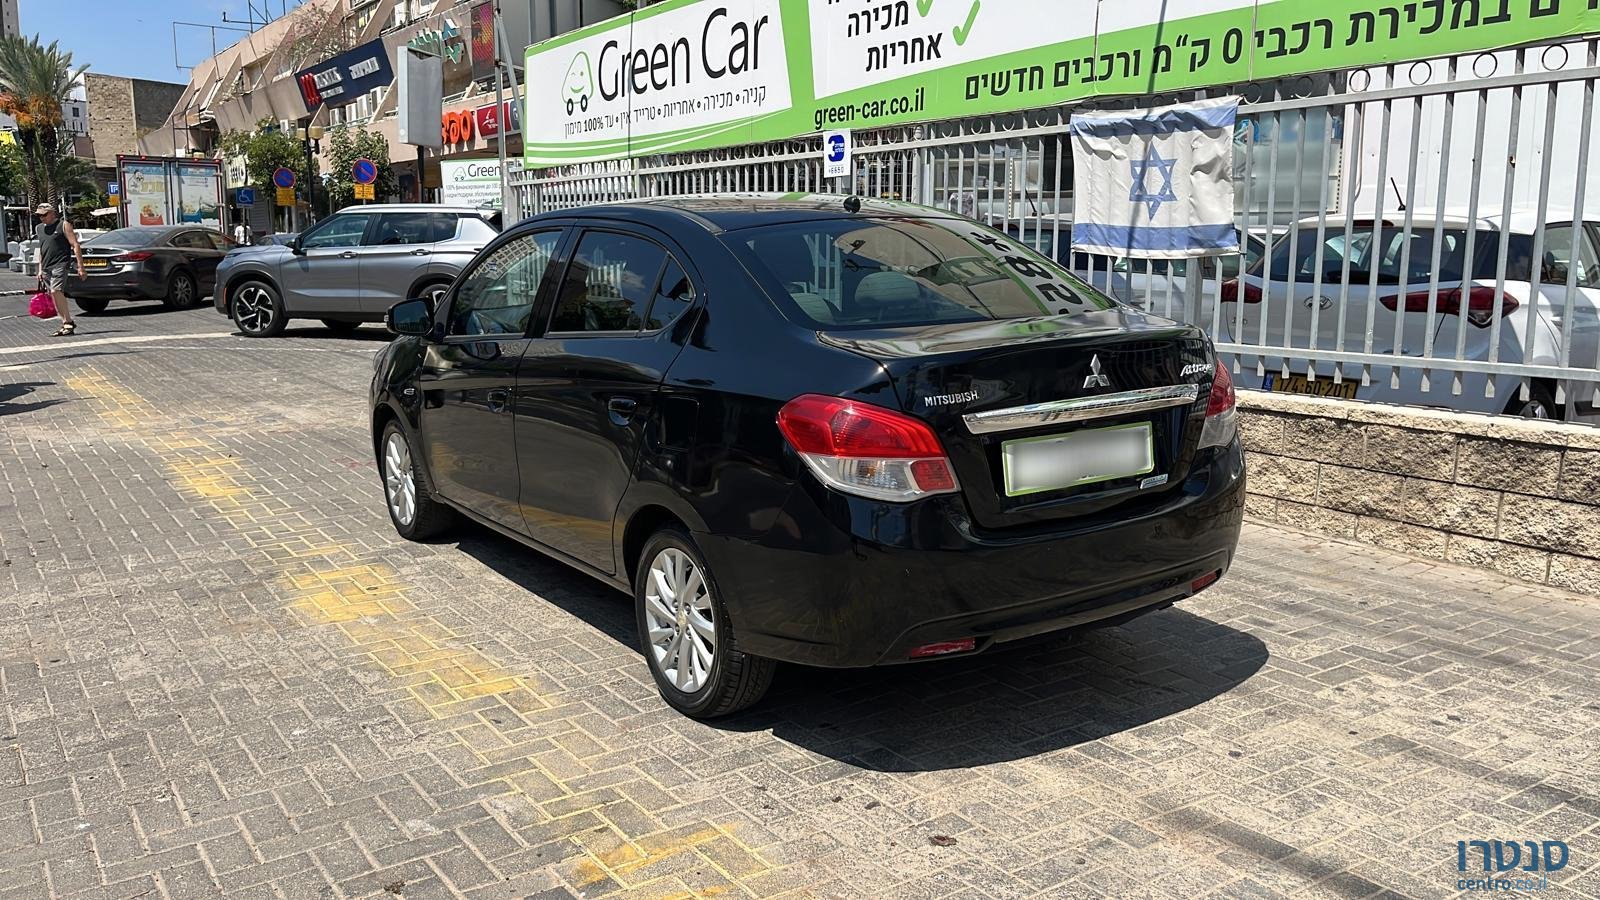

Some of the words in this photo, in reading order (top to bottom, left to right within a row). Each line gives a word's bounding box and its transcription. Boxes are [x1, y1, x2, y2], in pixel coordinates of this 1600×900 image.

[847, 0, 909, 38] מכירה
[1222, 27, 1243, 65] 0
[1254, 18, 1333, 59] רכבי
[598, 37, 691, 101] Green
[701, 7, 769, 79] Car
[865, 32, 943, 72] אחריות
[1053, 48, 1141, 88] ורכבים
[965, 64, 1043, 100] חדשים
[703, 91, 733, 112] מכירה
[742, 85, 766, 107] קניה
[634, 105, 656, 121] טרייד
[663, 98, 696, 118] אחריות
[814, 87, 925, 130] green-car.co.il
[565, 121, 582, 139] מימון
[584, 116, 604, 132] 100%
[604, 113, 614, 129] עד
[467, 164, 501, 177] Green
[924, 390, 980, 407] MITSUBISH
